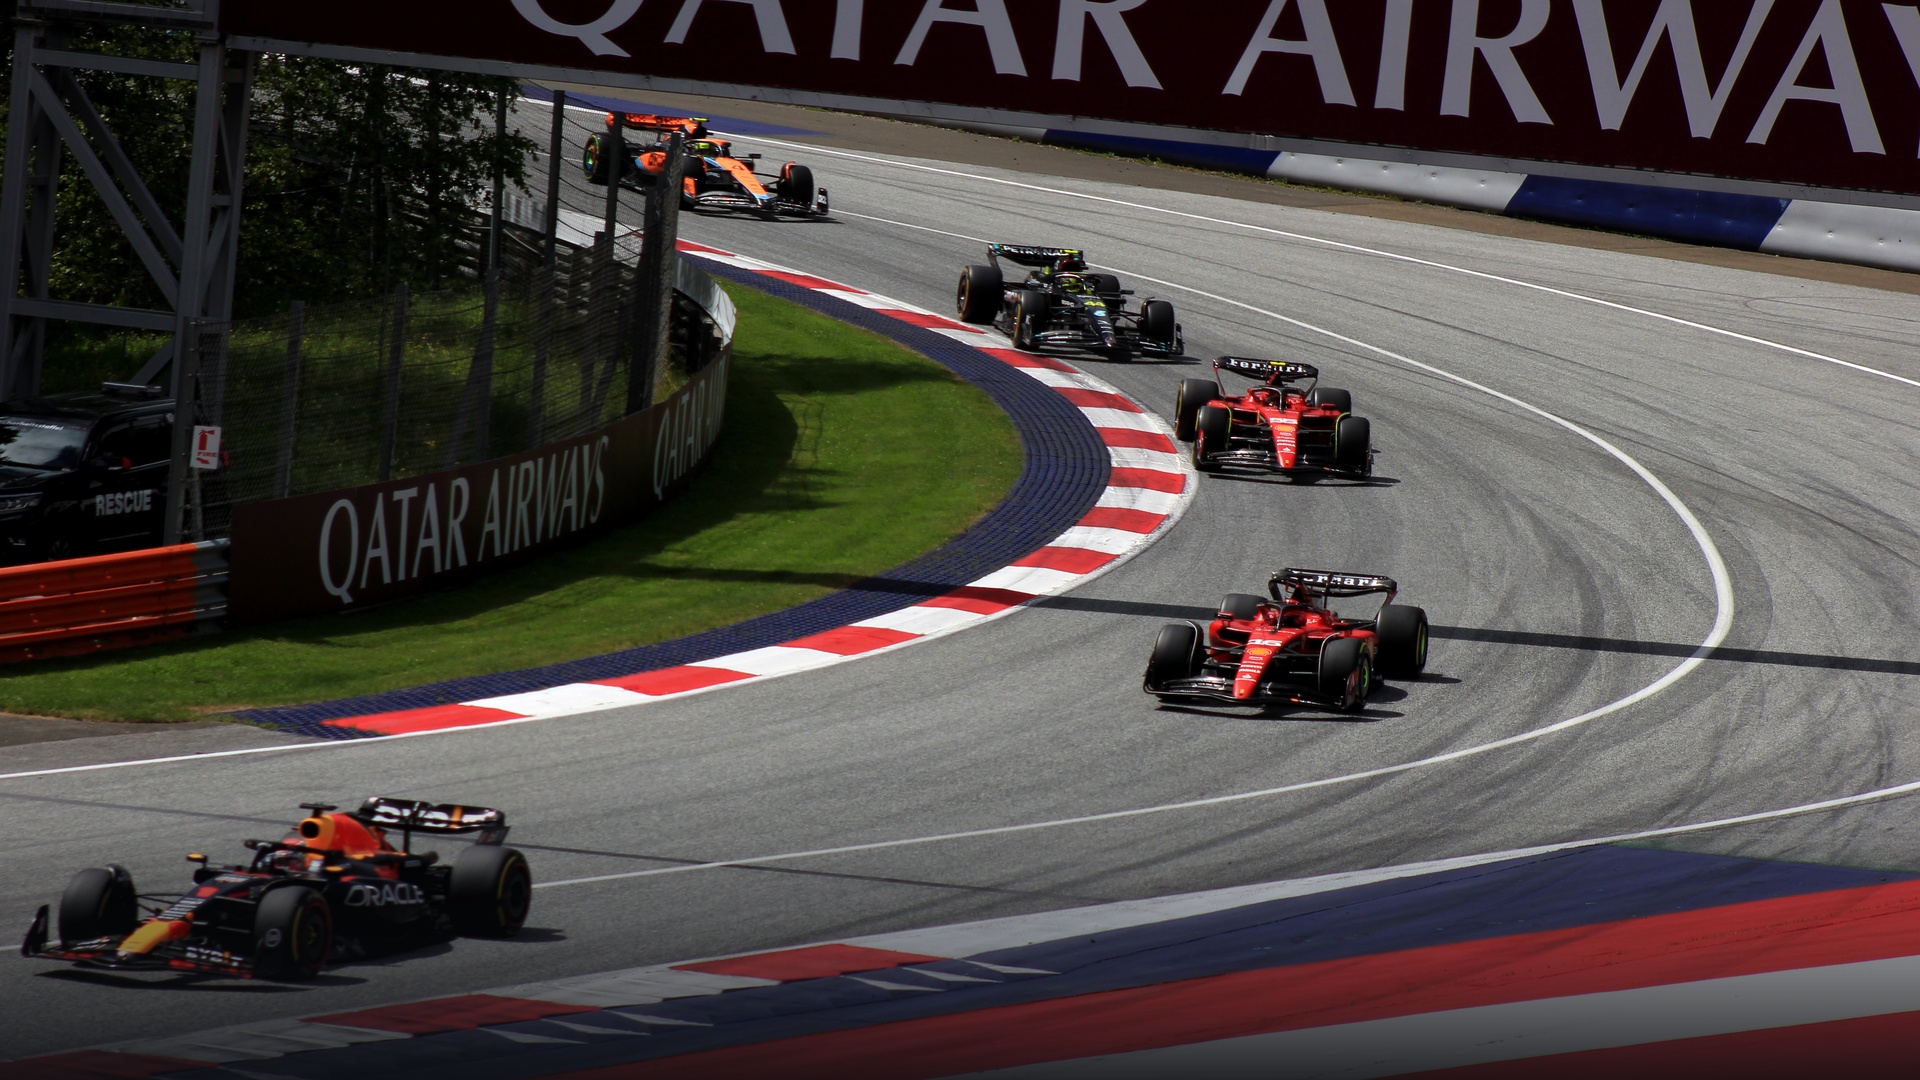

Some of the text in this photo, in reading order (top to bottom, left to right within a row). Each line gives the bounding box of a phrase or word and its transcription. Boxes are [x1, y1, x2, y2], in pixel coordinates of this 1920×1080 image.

[653, 378, 705, 501] QATAR
[95, 489, 152, 517] RESCUE
[319, 435, 609, 605] QATAR AIRWAYS
[1247, 639, 1282, 647] 16
[343, 882, 424, 907] ORACLE
